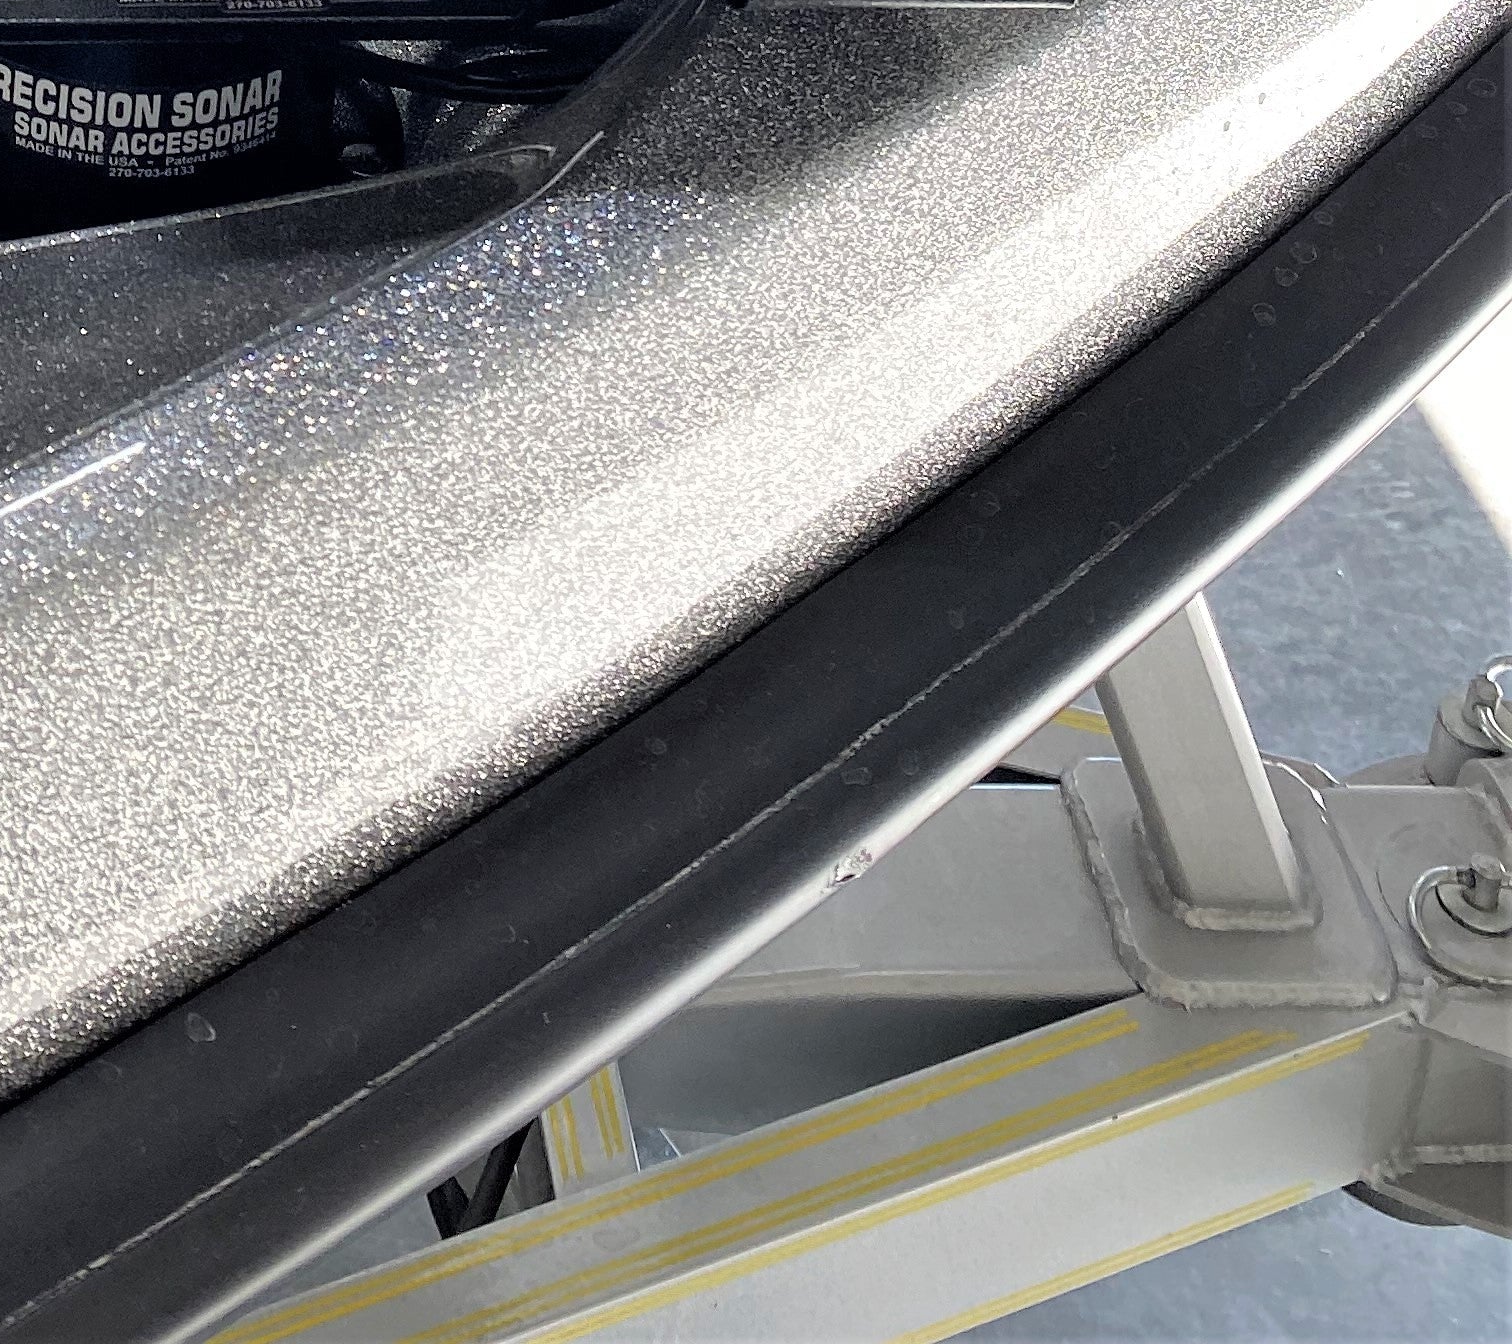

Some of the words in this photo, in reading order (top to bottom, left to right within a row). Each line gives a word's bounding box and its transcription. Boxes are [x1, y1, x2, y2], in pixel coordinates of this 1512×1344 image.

[171, 69, 282, 127] SONAR
[14, 111, 105, 154] SONAR
[111, 106, 279, 155] ACCESSORIES
[15, 136, 54, 156] MADE
[57, 148, 72, 160] IN
[76, 151, 104, 166] THE
[108, 155, 138, 167] USA
[165, 152, 206, 167] Patent
[109, 166, 194, 178] 270-703-6133
